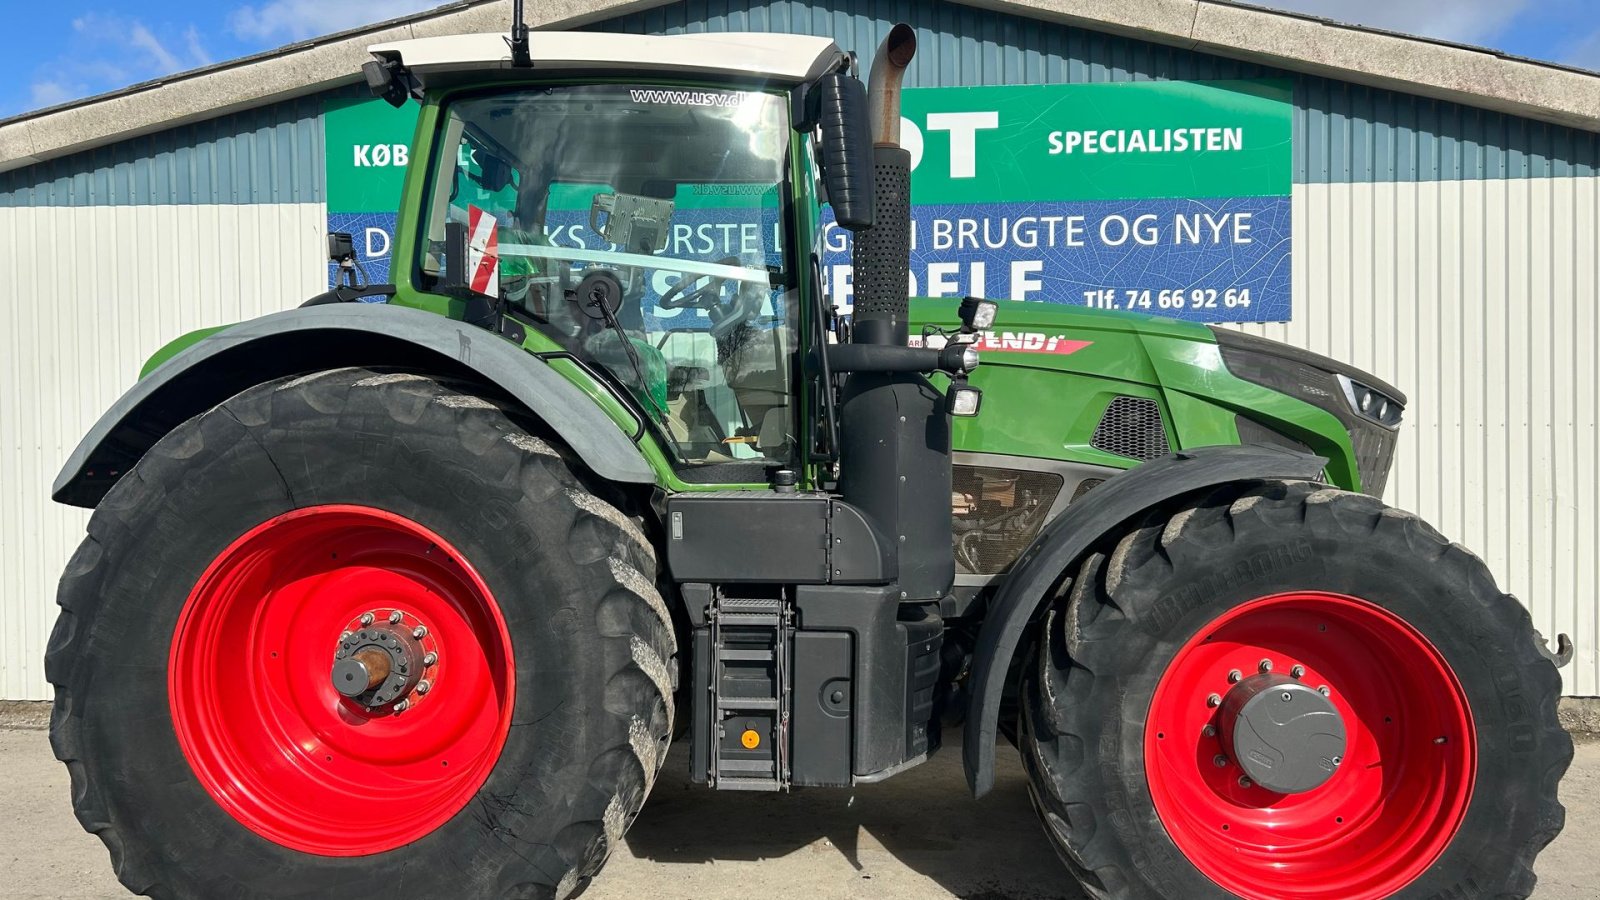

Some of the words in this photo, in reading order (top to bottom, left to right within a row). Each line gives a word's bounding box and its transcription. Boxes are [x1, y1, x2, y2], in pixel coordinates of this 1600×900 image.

[630, 88, 745, 107] www.usv.d
[1048, 127, 1242, 154] SPECIALISTEN
[355, 144, 408, 167] KØB
[933, 216, 1085, 250] BRUGTE
[1099, 214, 1158, 246] OG
[1175, 213, 1252, 245] NYE
[1084, 290, 1119, 310] Tlf.
[1125, 290, 1152, 310] 74
[1158, 289, 1186, 309] 66
[1191, 289, 1218, 309] 92
[1224, 288, 1251, 308] 64
